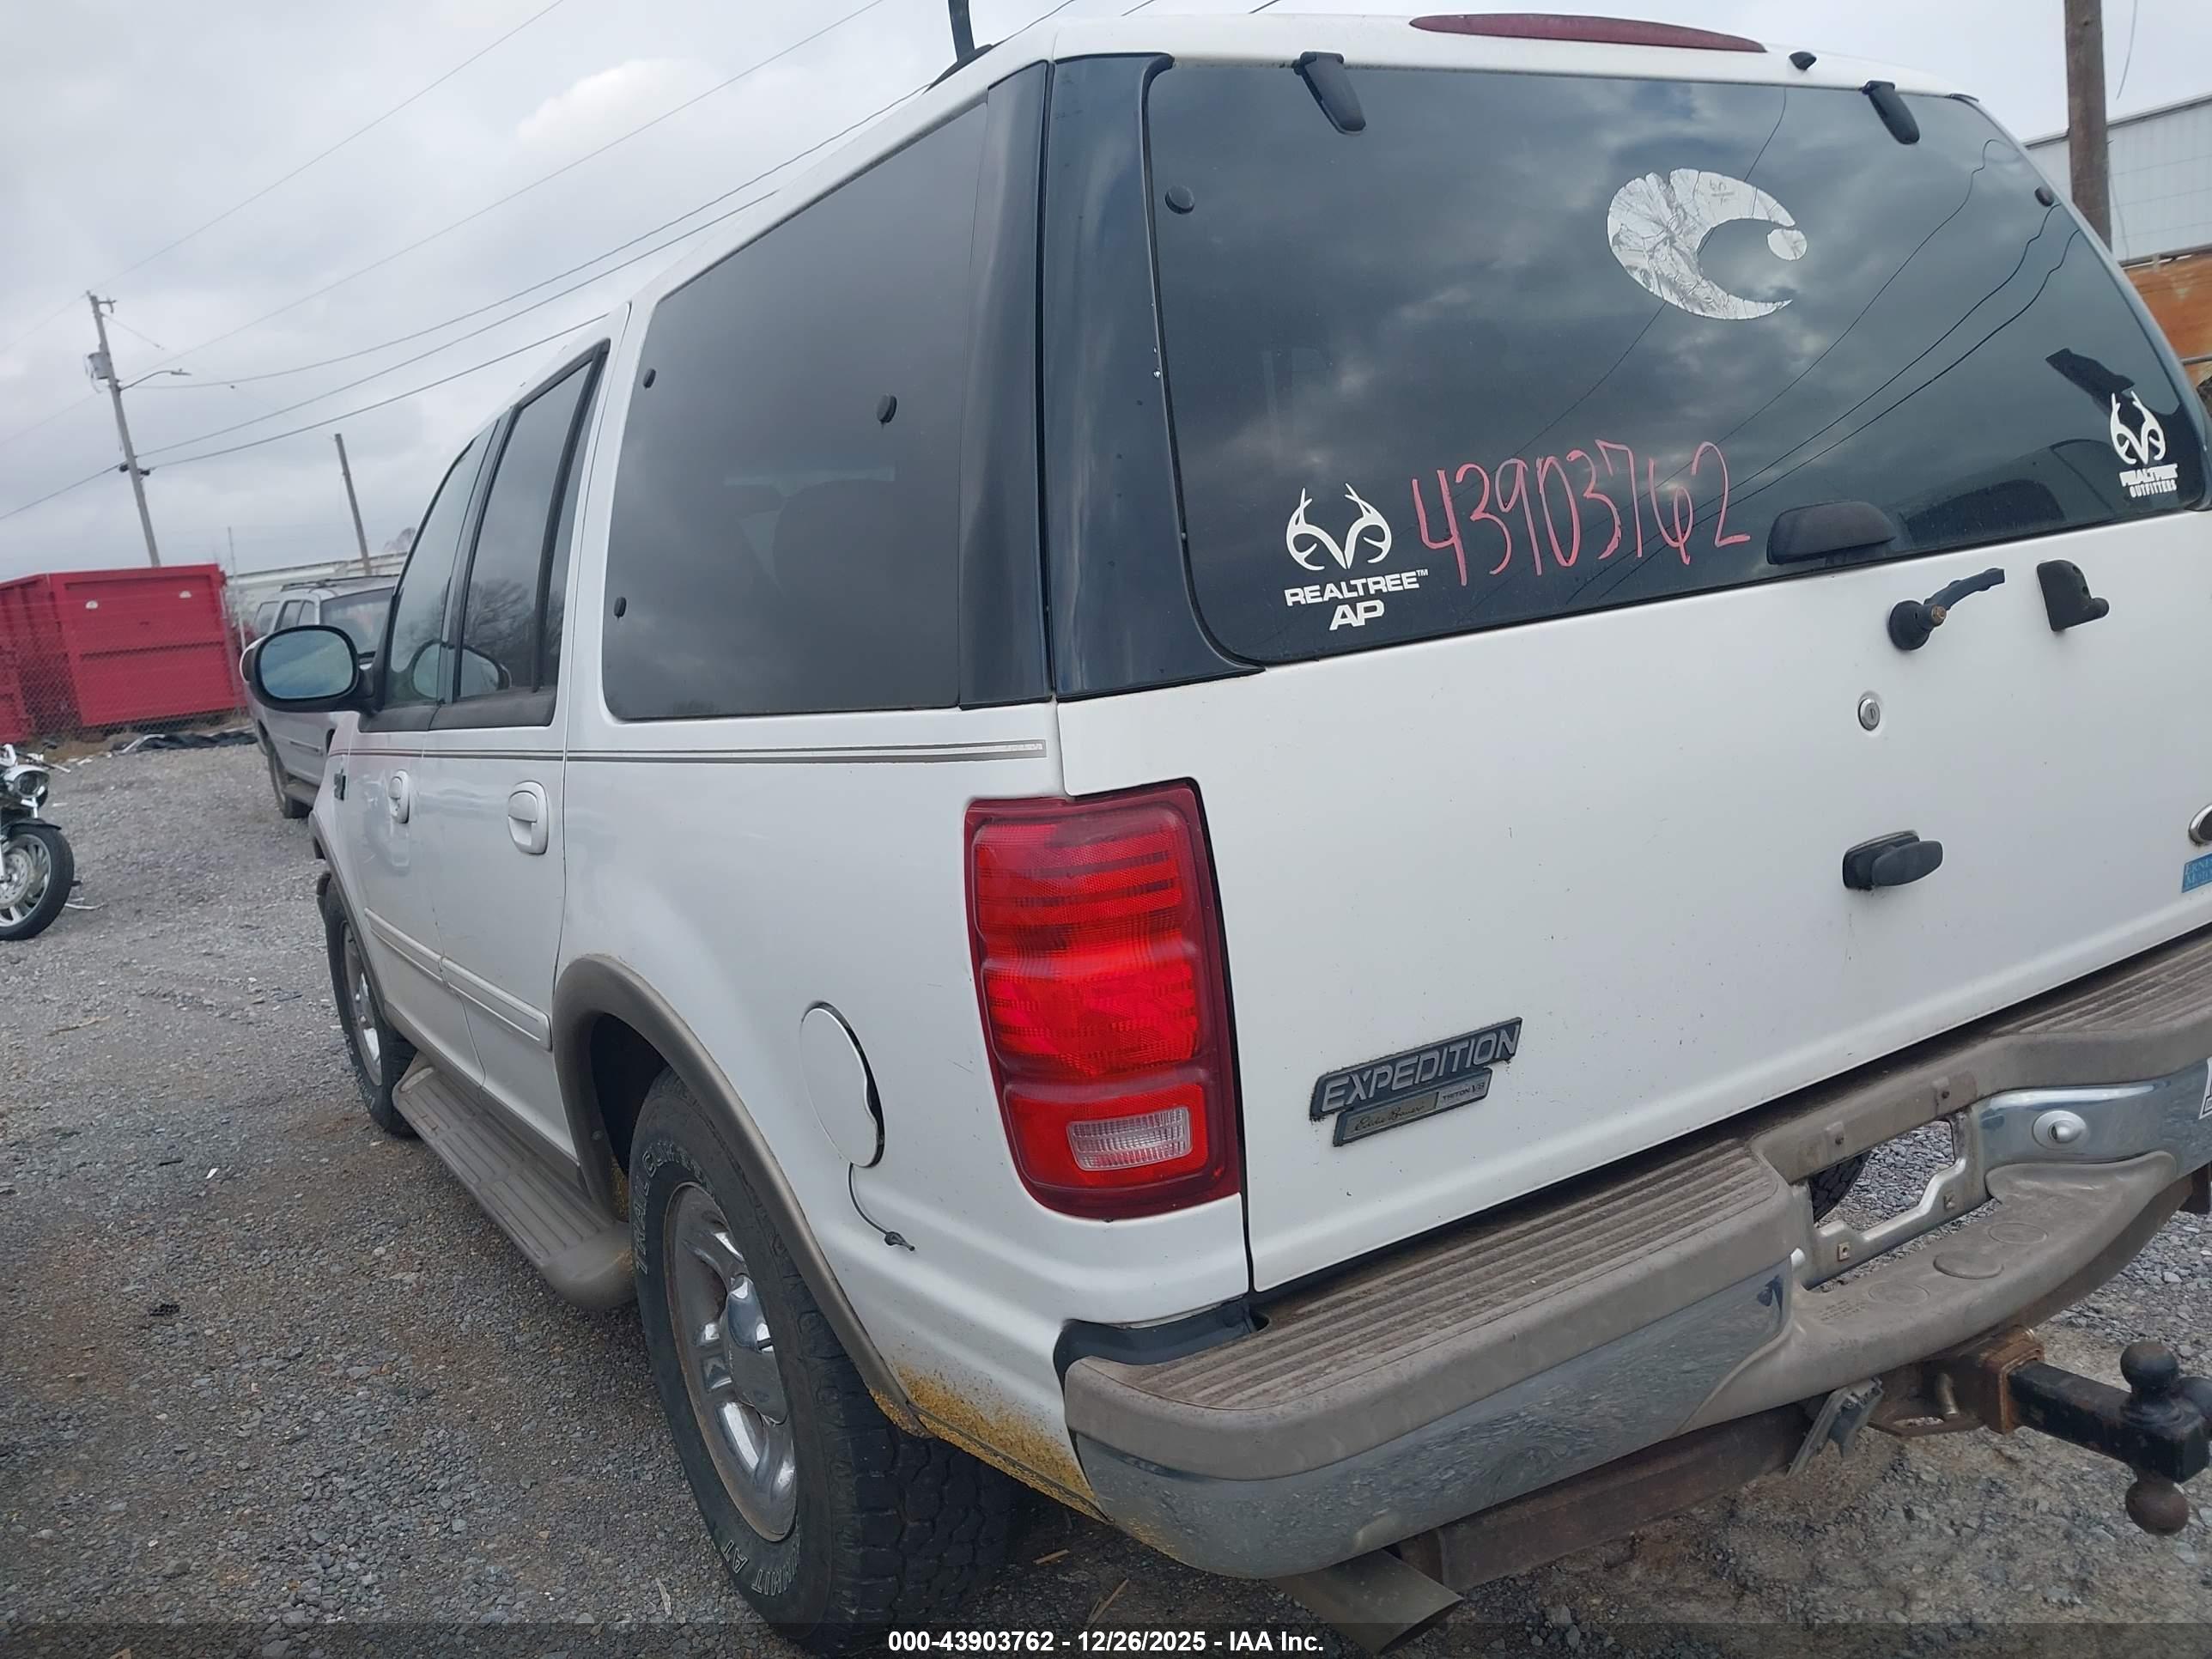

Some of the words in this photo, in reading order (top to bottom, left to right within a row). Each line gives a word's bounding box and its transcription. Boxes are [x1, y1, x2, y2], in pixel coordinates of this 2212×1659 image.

[2129, 478, 2178, 498] OUTFITTERS
[1413, 439, 1751, 586] 43903762
[1329, 599, 1385, 631] AP
[1320, 1024, 1521, 1113] EXPEDITION
[1443, 1086, 1471, 1102] TRITON
[1472, 1081, 1486, 1095] V8
[720, 1539, 749, 1574] AT
